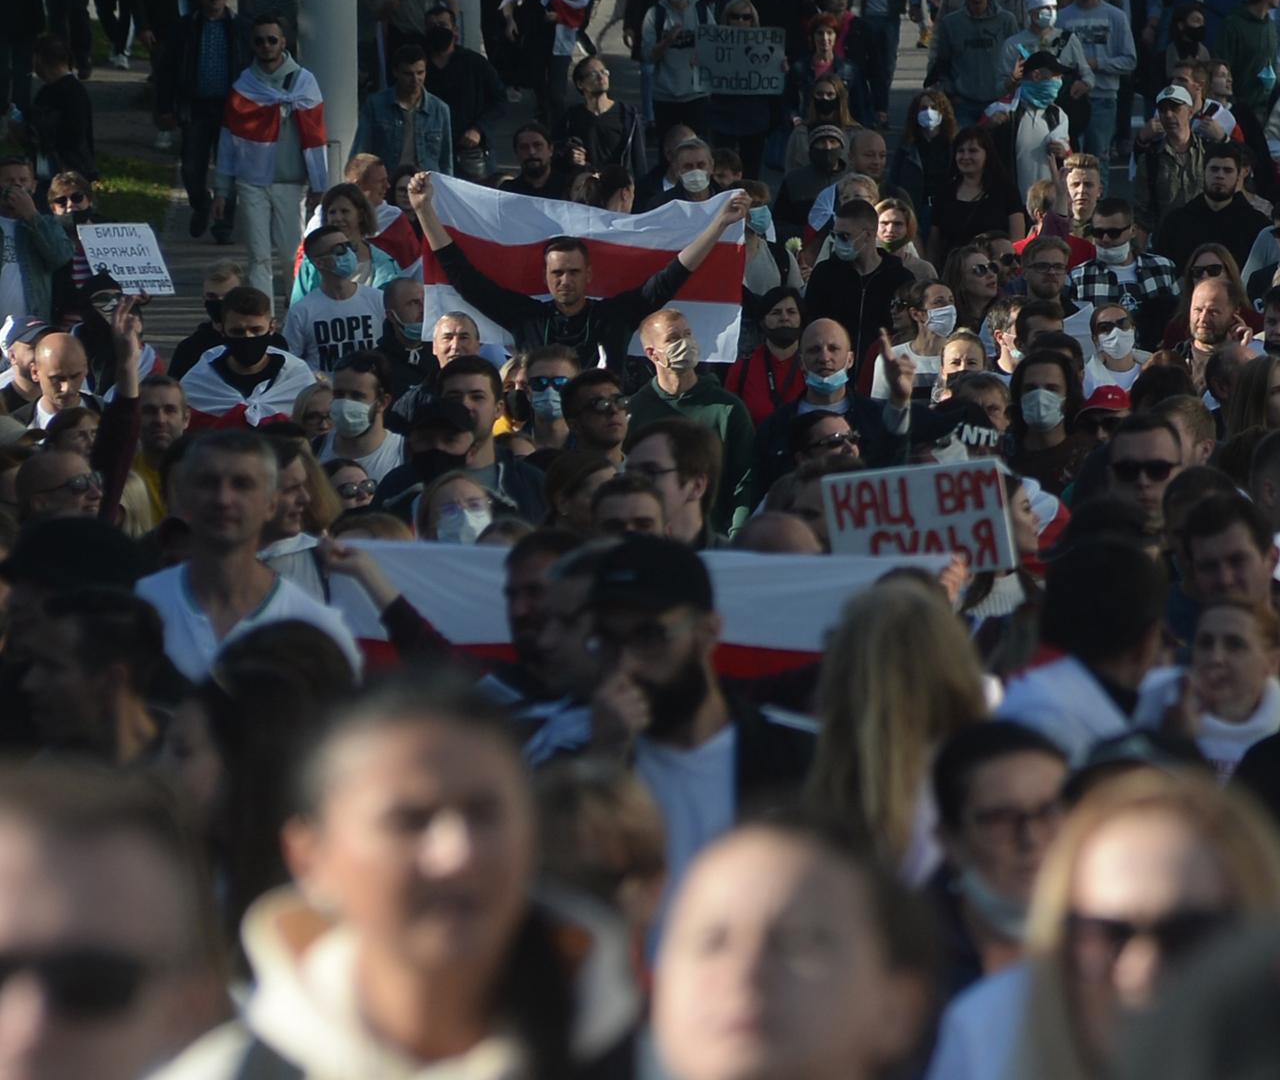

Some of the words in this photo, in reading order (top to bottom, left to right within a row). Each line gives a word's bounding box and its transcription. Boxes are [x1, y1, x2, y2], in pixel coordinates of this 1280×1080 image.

[94, 226, 142, 239] БИЛЛИ,
[314, 315, 373, 344] DOPE
[830, 476, 916, 531] КАЦ
[934, 467, 1003, 516] ВАМ
